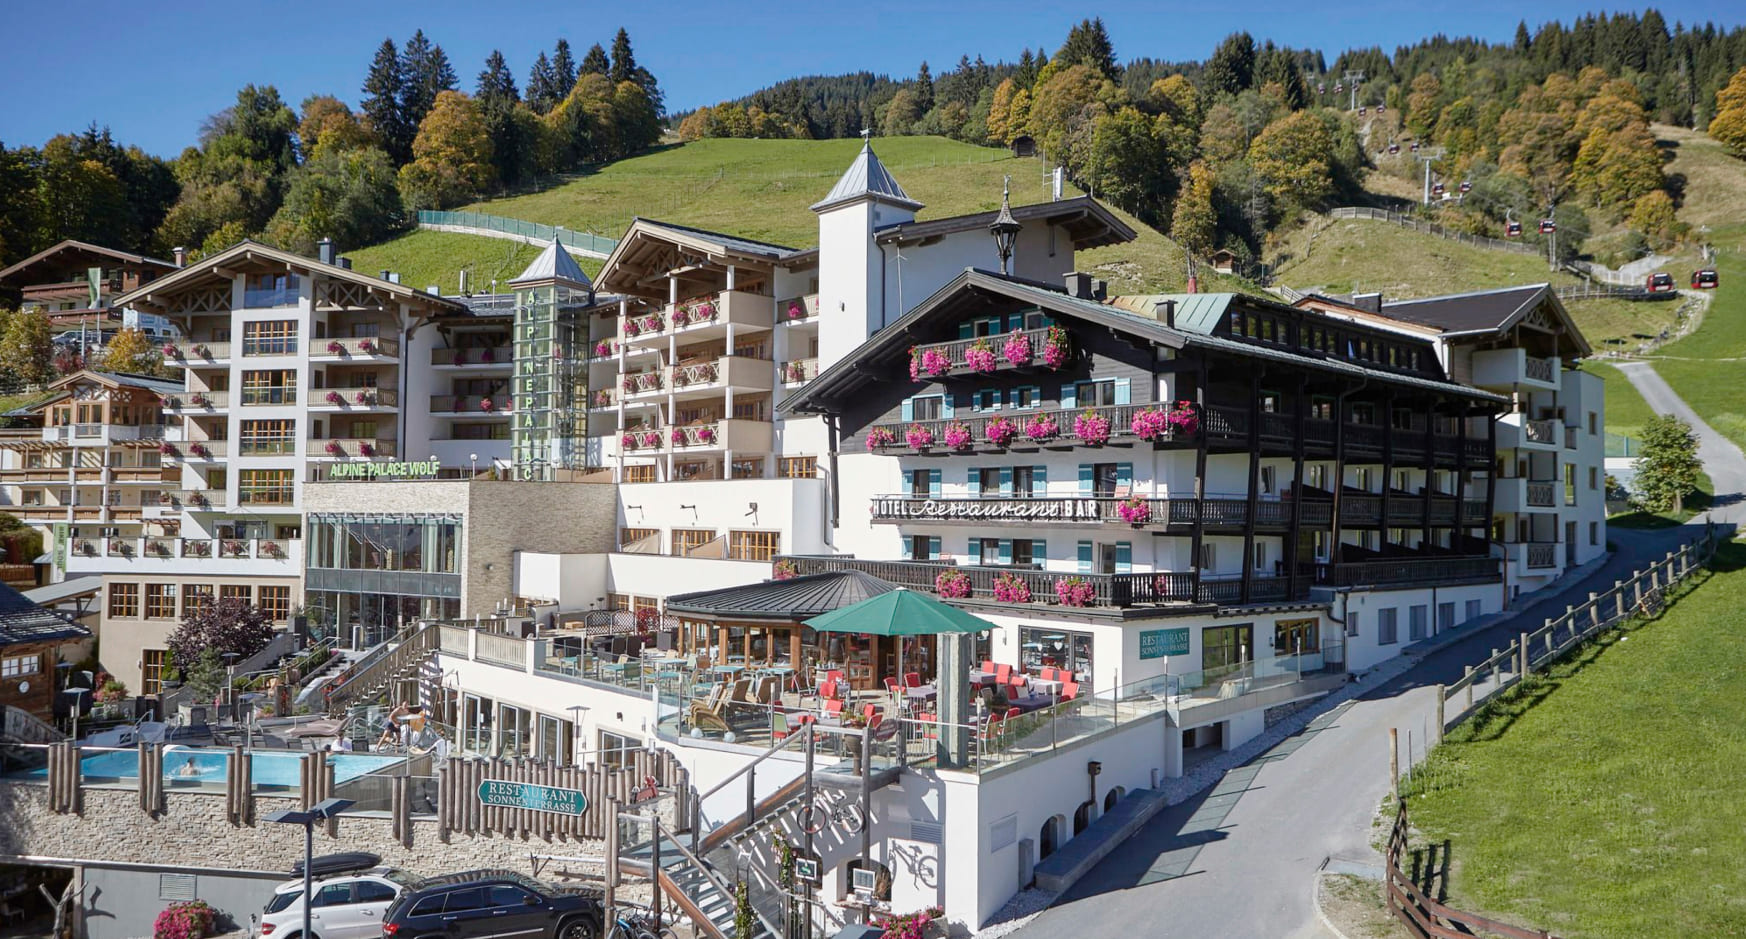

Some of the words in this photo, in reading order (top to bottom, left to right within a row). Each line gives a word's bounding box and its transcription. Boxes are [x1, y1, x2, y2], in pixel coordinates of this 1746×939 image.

[330, 463, 366, 476] ALPINE
[367, 462, 408, 476] PALACE
[409, 461, 440, 475] WOLF
[873, 500, 907, 516] HOTEL
[910, 499, 1058, 517] Restaurant
[1065, 500, 1098, 517] BAR
[489, 782, 577, 803] RESTAURANT
[488, 794, 576, 813] SONNENTERRASSE
